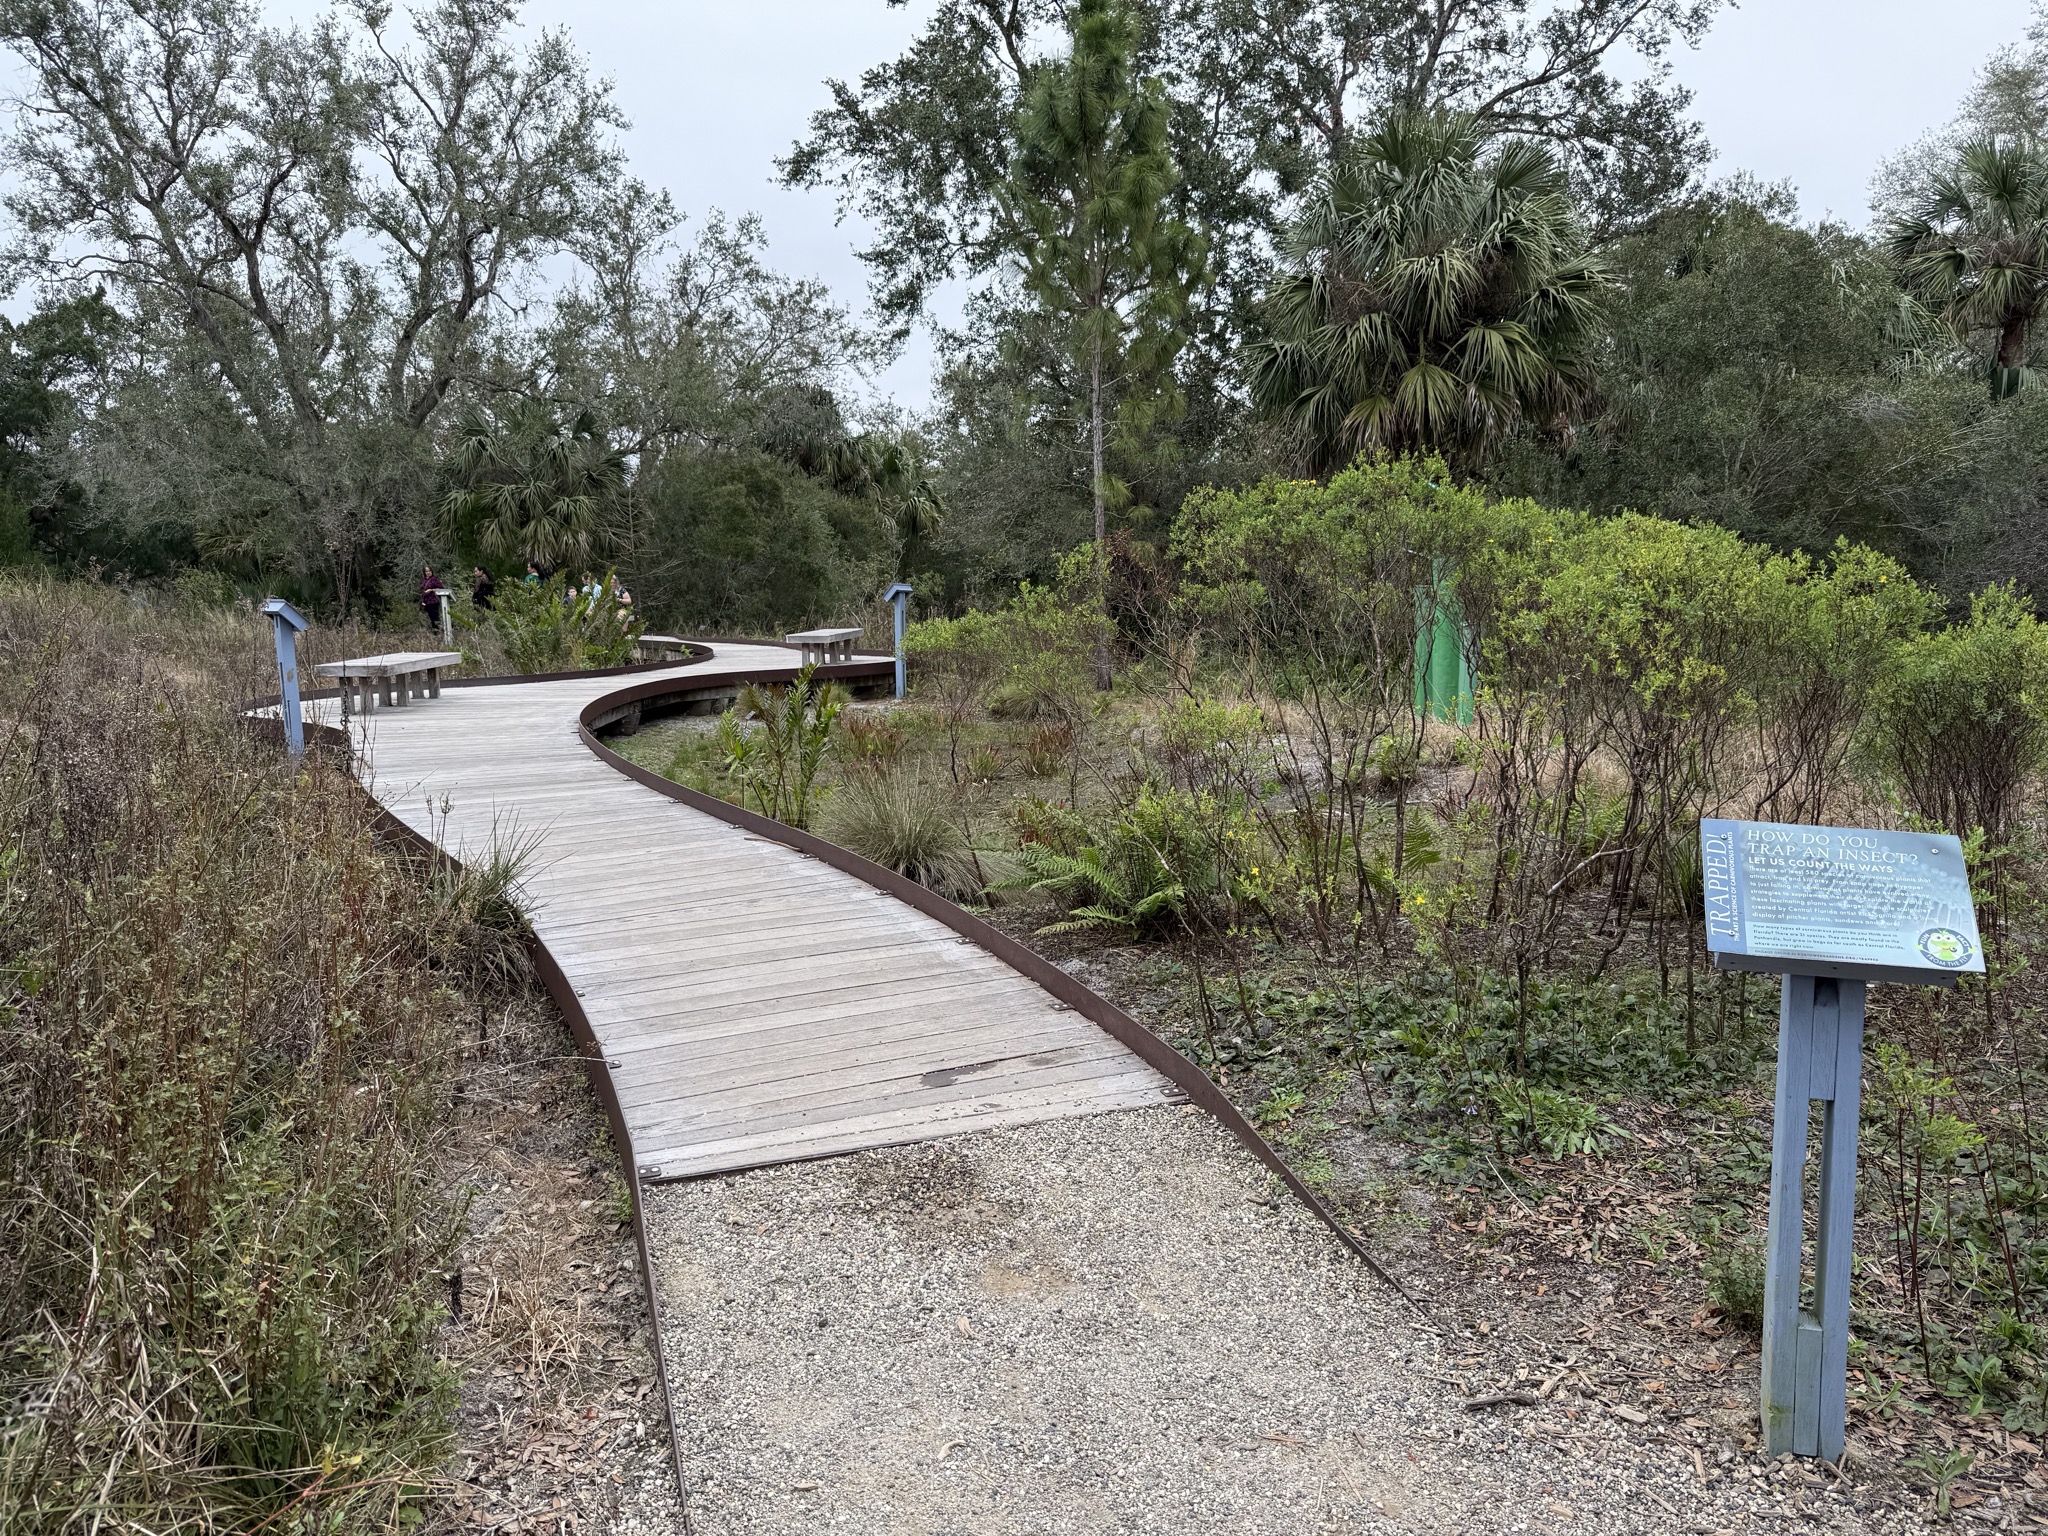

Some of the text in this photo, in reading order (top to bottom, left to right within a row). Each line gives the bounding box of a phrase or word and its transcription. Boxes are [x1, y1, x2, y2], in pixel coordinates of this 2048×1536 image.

[1748, 830, 1878, 848] HOW DO YOU
[1747, 843, 1918, 864] TRAP AN INSECT?
[1748, 856, 1766, 864] LET
[1788, 859, 1830, 868] COUNT
[1834, 862, 1855, 870] THE
[1858, 864, 1894, 873] WAYS
[1706, 833, 1731, 936] TRAPPED!
[1770, 898, 1805, 906] fascinating
[1926, 954, 1946, 966] FROM
